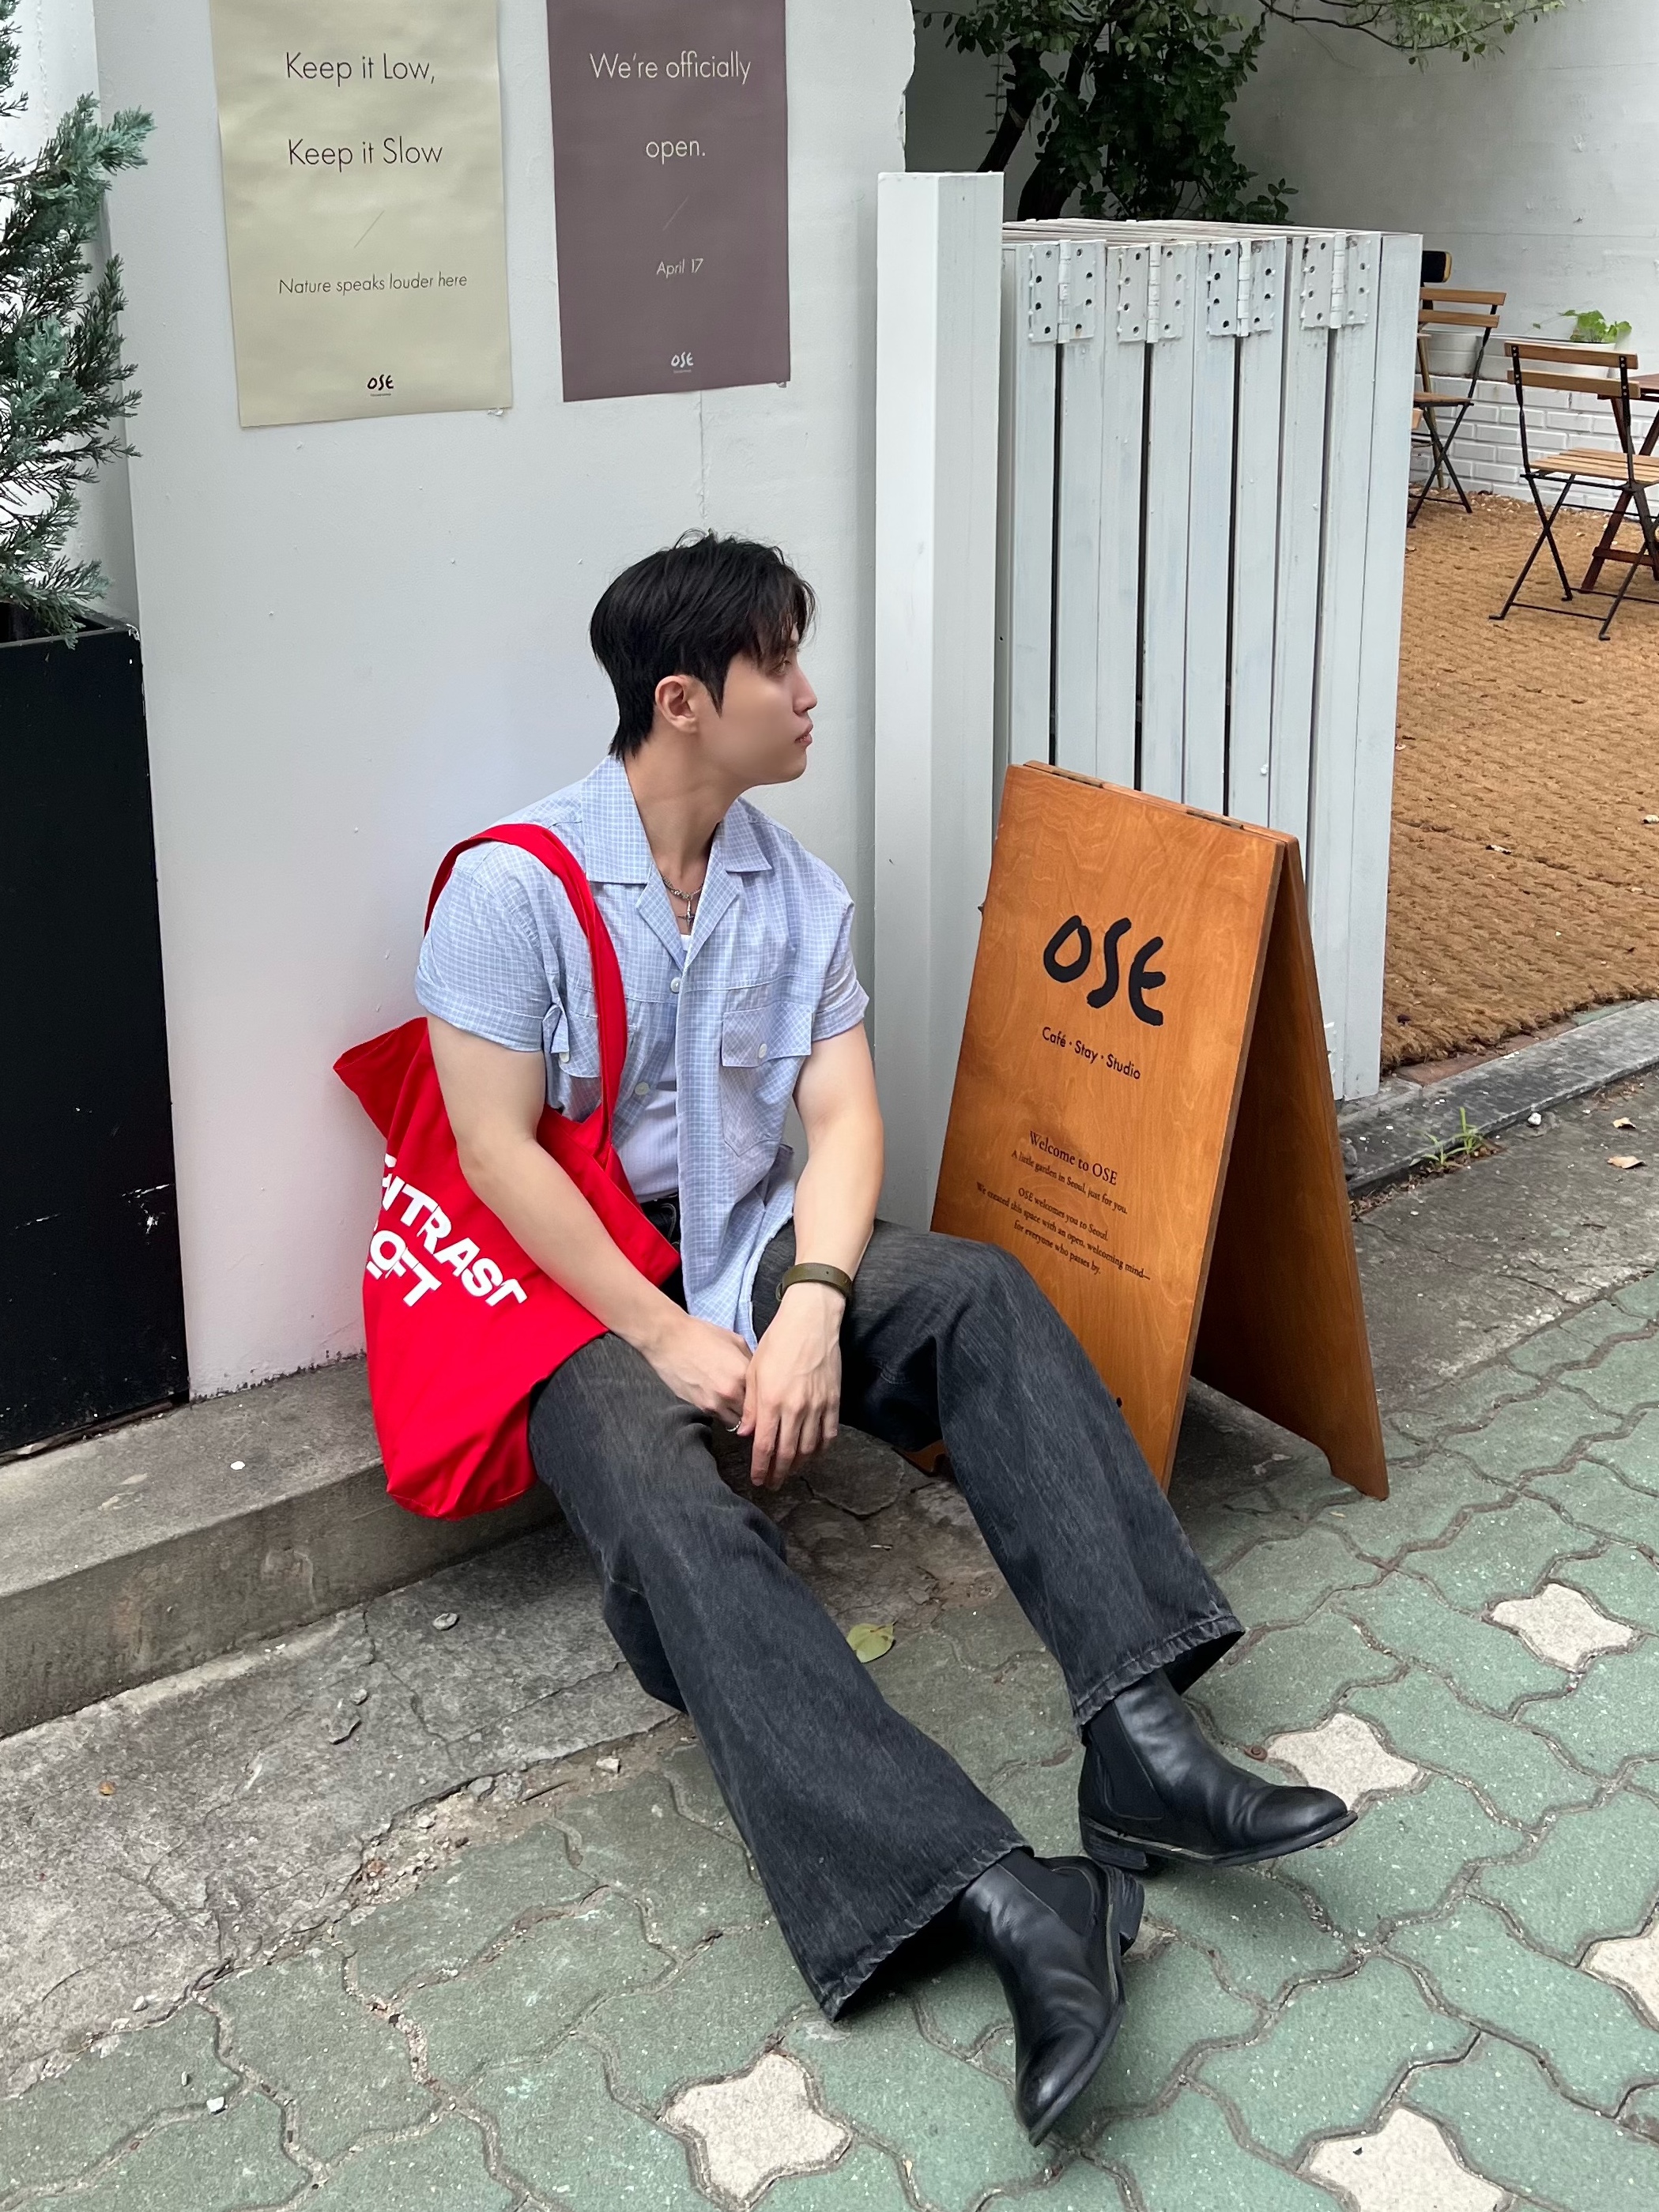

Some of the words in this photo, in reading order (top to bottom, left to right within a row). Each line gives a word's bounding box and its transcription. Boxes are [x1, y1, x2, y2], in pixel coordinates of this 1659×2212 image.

[286, 51, 353, 88] Keep
[362, 55, 374, 79] it
[383, 52, 434, 85] Low,
[590, 52, 658, 78] We're
[665, 50, 751, 85] officially
[288, 138, 353, 173] Keep
[362, 141, 374, 164] it
[383, 135, 443, 164] Slow
[646, 140, 706, 164] open.
[279, 278, 331, 294] Nature
[336, 273, 385, 296] speaks
[390, 272, 434, 289] louder
[439, 271, 467, 287] here
[656, 258, 685, 279] April
[692, 258, 704, 273] 17
[671, 351, 694, 368] OSE
[367, 374, 394, 391] OSE
[1043, 914, 1167, 1027] OSE
[1042, 1026, 1067, 1048] Café
[1074, 1039, 1099, 1065] Stay
[1106, 1053, 1141, 1080] Studio
[1030, 1130, 1076, 1166] Welcome
[1078, 1159, 1089, 1171] to
[1092, 1163, 1118, 1185] OSE
[1012, 1149, 1018, 1159] A
[1019, 1151, 1035, 1167] little
[1035, 1163, 1058, 1179] garden
[1058, 1172, 1065, 1183] in
[1087, 1187, 1101, 1200] just
[1102, 1193, 1113, 1207] for
[1112, 1201, 1128, 1215] you.
[976, 1181, 987, 1195] We
[987, 1191, 1011, 1207] created
[1010, 1200, 1023, 1214] this
[1024, 1210, 1041, 1223] space
[1042, 1219, 1057, 1233] with
[1058, 1227, 1066, 1238] an
[1067, 1233, 1085, 1249] open,
[1087, 1243, 1124, 1271] welcoming
[1018, 1187, 1034, 1202] OSE
[1034, 1197, 1065, 1219] welcomes
[1065, 1214, 1079, 1226] you
[1080, 1220, 1088, 1230] to
[1013, 1219, 1024, 1232] for
[1024, 1229, 1054, 1249] everyone
[1054, 1243, 1069, 1257] who
[1069, 1252, 1090, 1268] passes
[1091, 1260, 1101, 1276] by.
